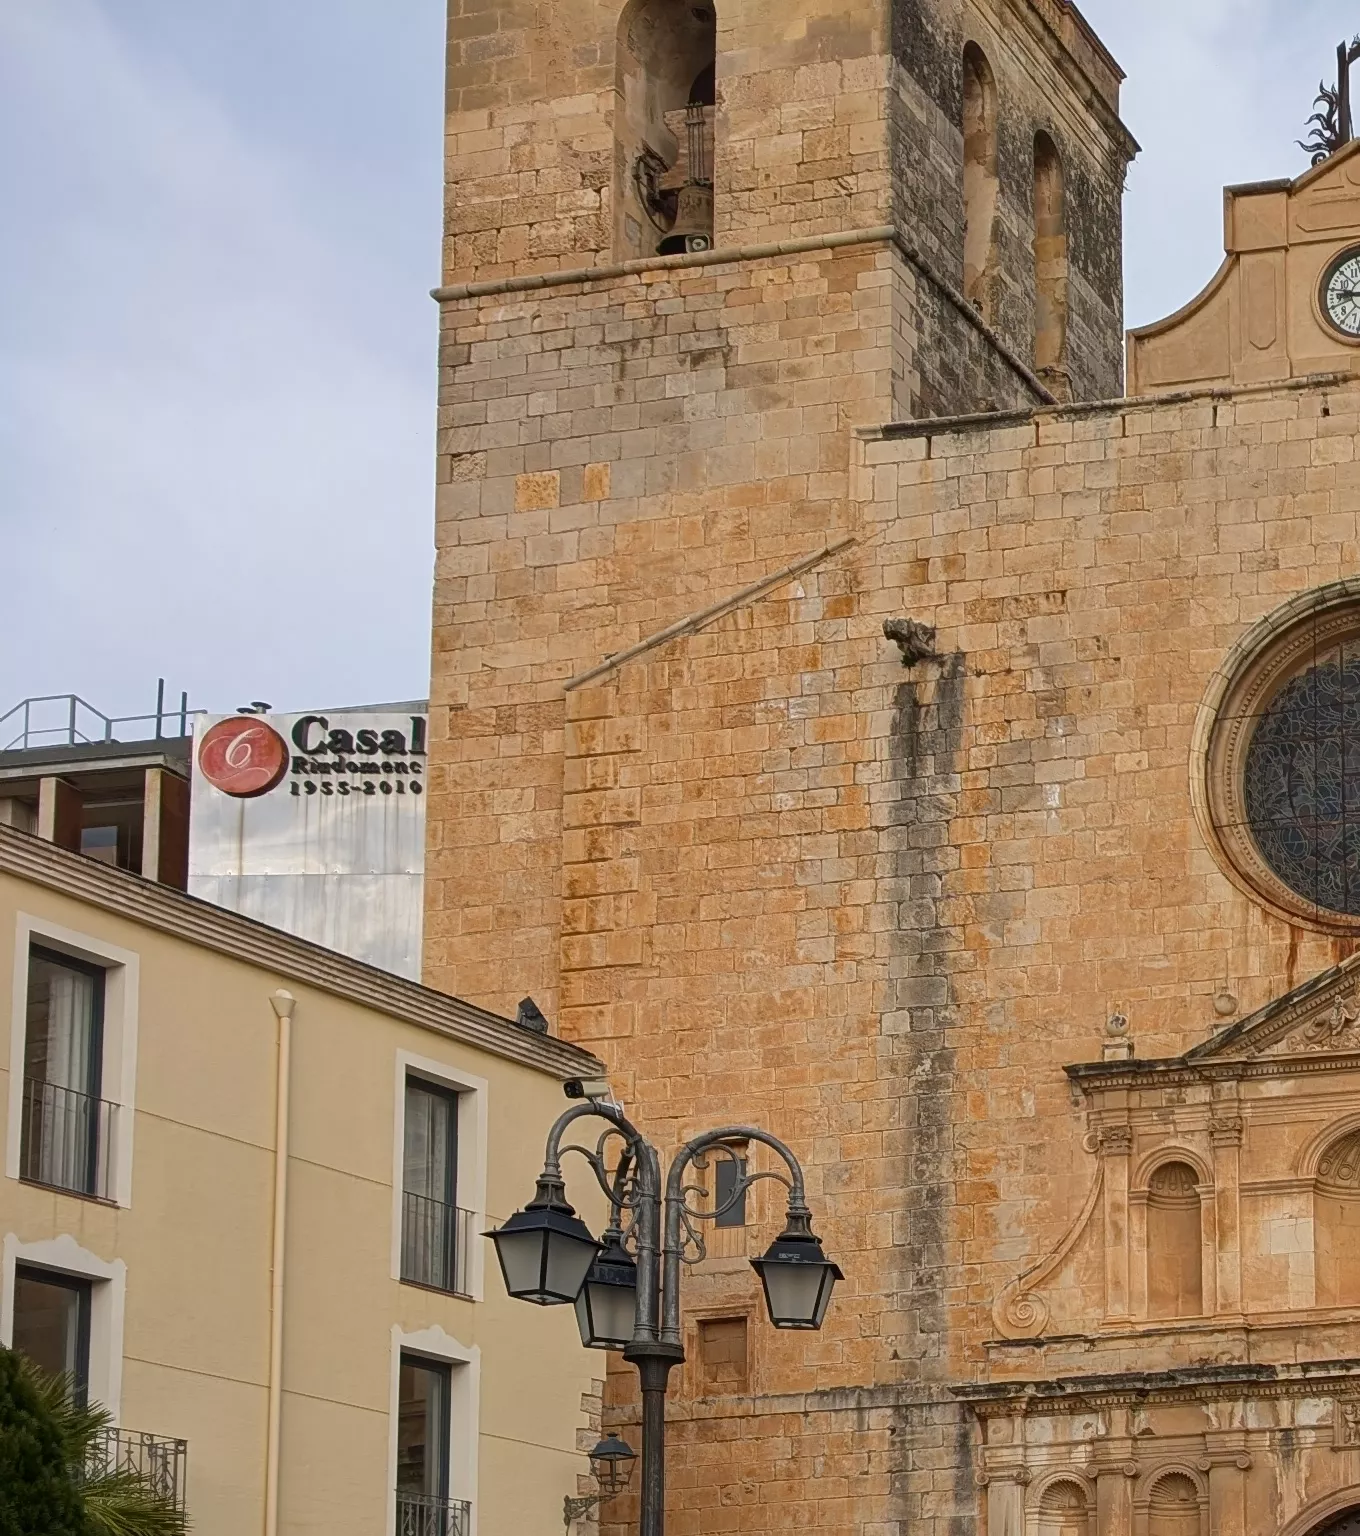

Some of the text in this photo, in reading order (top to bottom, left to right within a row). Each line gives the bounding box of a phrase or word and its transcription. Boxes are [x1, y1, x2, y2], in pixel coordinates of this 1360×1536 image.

[1350, 268, 1358, 278] 11
[1340, 279, 1349, 290] 10
[1340, 306, 1347, 316] 8
[1352, 313, 1357, 324] 7
[292, 716, 427, 755] Casal
[290, 780, 423, 796] 1955-2010
